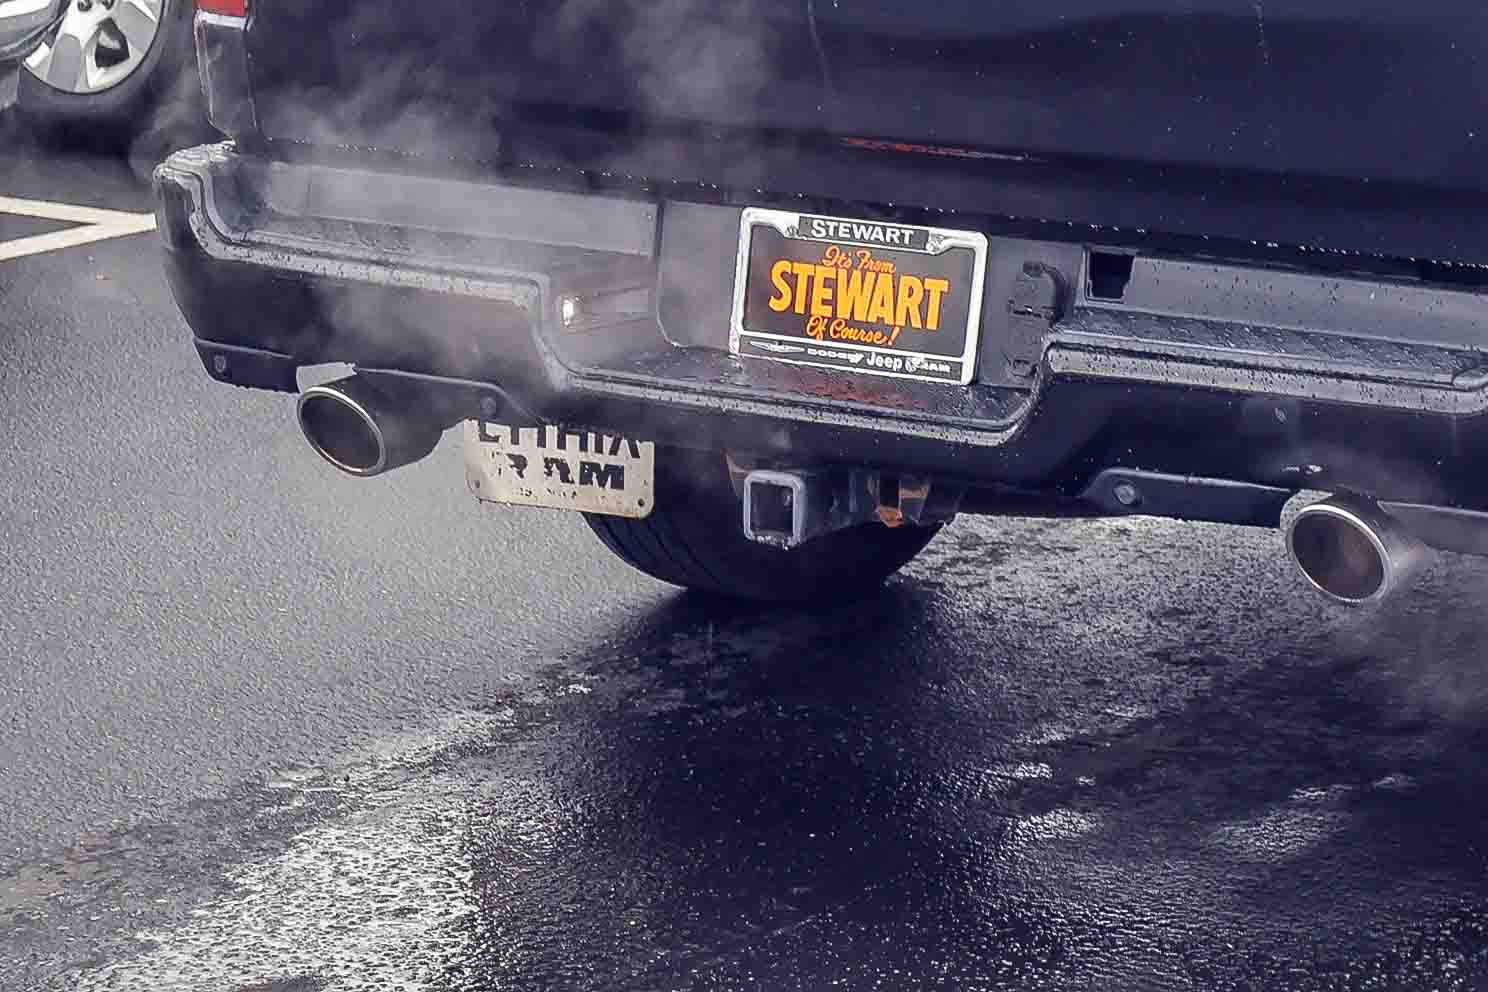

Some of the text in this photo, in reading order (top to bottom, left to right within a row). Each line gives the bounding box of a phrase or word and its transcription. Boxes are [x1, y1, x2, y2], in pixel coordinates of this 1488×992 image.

[811, 219, 914, 245] STEWART
[768, 260, 949, 331] STEWART
[866, 351, 902, 372] Jeep
